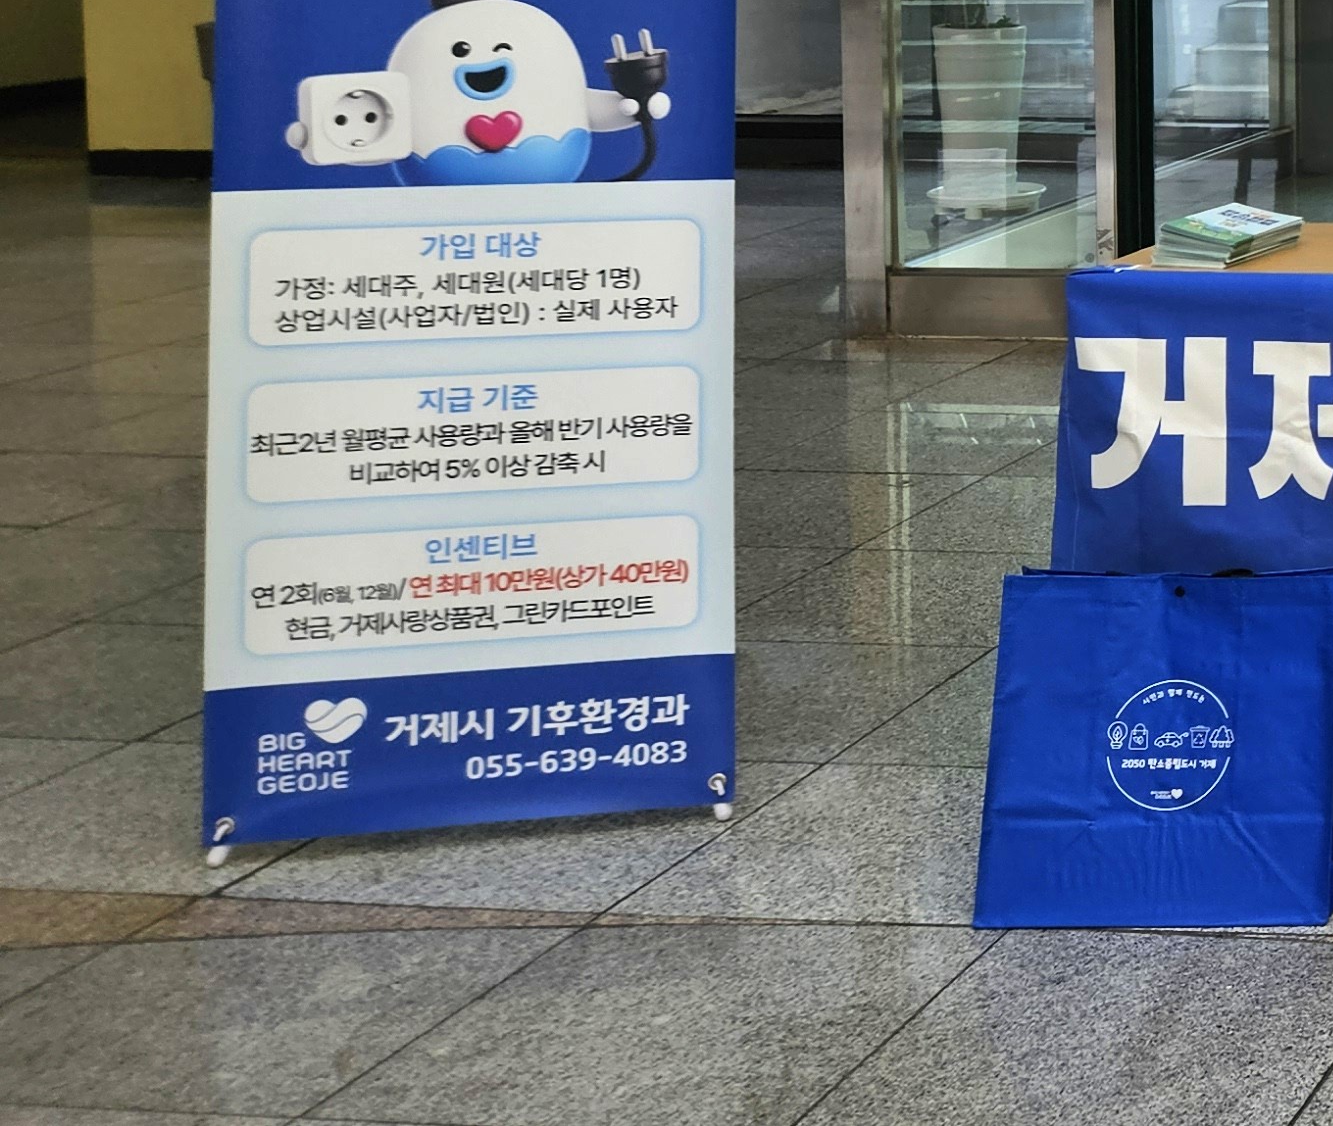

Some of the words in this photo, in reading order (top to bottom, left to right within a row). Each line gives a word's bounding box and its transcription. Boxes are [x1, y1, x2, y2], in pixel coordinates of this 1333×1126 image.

[419, 232, 476, 262] 가입
[485, 231, 542, 260] 대상
[274, 276, 335, 301] 가정:
[342, 273, 424, 301] 세대주,
[432, 267, 590, 296] 세대원(세대당
[597, 266, 642, 291] 1명)
[274, 301, 531, 334] 상업시설(사업자/법인)
[552, 297, 601, 323] 실제
[606, 295, 679, 321] 사용자
[416, 385, 475, 415] 지급
[482, 384, 539, 412] 기준
[249, 431, 338, 457] 최근2년
[341, 425, 412, 454] 월평균
[413, 421, 506, 450] 사용량과
[508, 418, 555, 445] 올해
[558, 415, 603, 443] 반기
[605, 411, 694, 440] 사용량을
[348, 457, 439, 486] 비교하여
[445, 457, 481, 480] 5%
[485, 453, 532, 479] 이상
[534, 451, 580, 476] 감축
[583, 449, 607, 474] 시
[424, 532, 539, 565] 인센티브
[250, 584, 278, 610] 연
[408, 573, 435, 600] 연
[436, 571, 482, 598] 최대
[486, 562, 607, 596] 10만원(상가
[609, 558, 690, 587] 40만원)
[284, 614, 337, 643] 현금,
[339, 603, 500, 639] 거제사랑상품권,
[501, 594, 656, 627] 그린카드포인트
[384, 706, 496, 748] 거제시
[506, 692, 691, 739] 기후환경과
[258, 732, 308, 754] BIG
[465, 739, 688, 781] 055-639-4083
[257, 748, 353, 774] HEART
[1121, 759, 1146, 769] 2050
[1199, 759, 1217, 770] 거제
[256, 770, 350, 795] GEOJE
